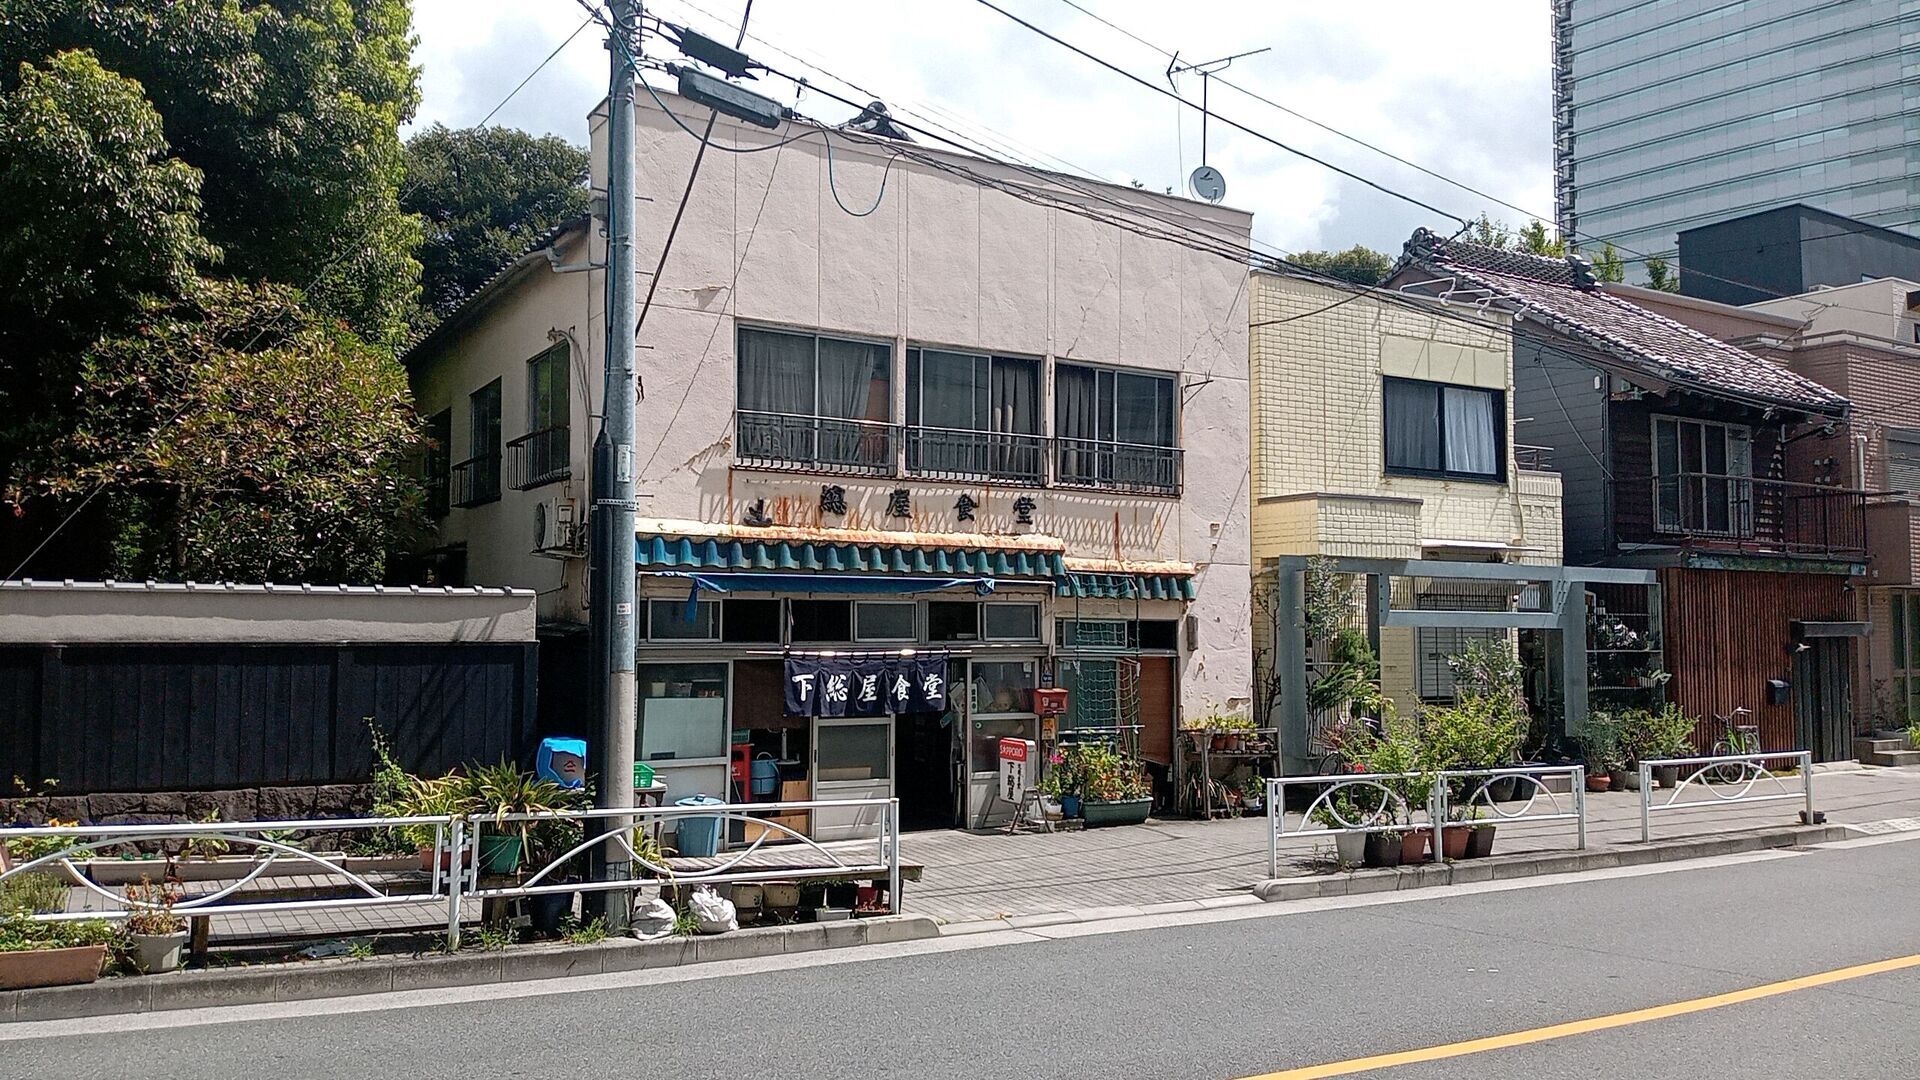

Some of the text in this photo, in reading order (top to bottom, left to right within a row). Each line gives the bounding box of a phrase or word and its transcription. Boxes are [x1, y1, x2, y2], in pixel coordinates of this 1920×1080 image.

[791, 673, 943, 702] 下総屋食堂
